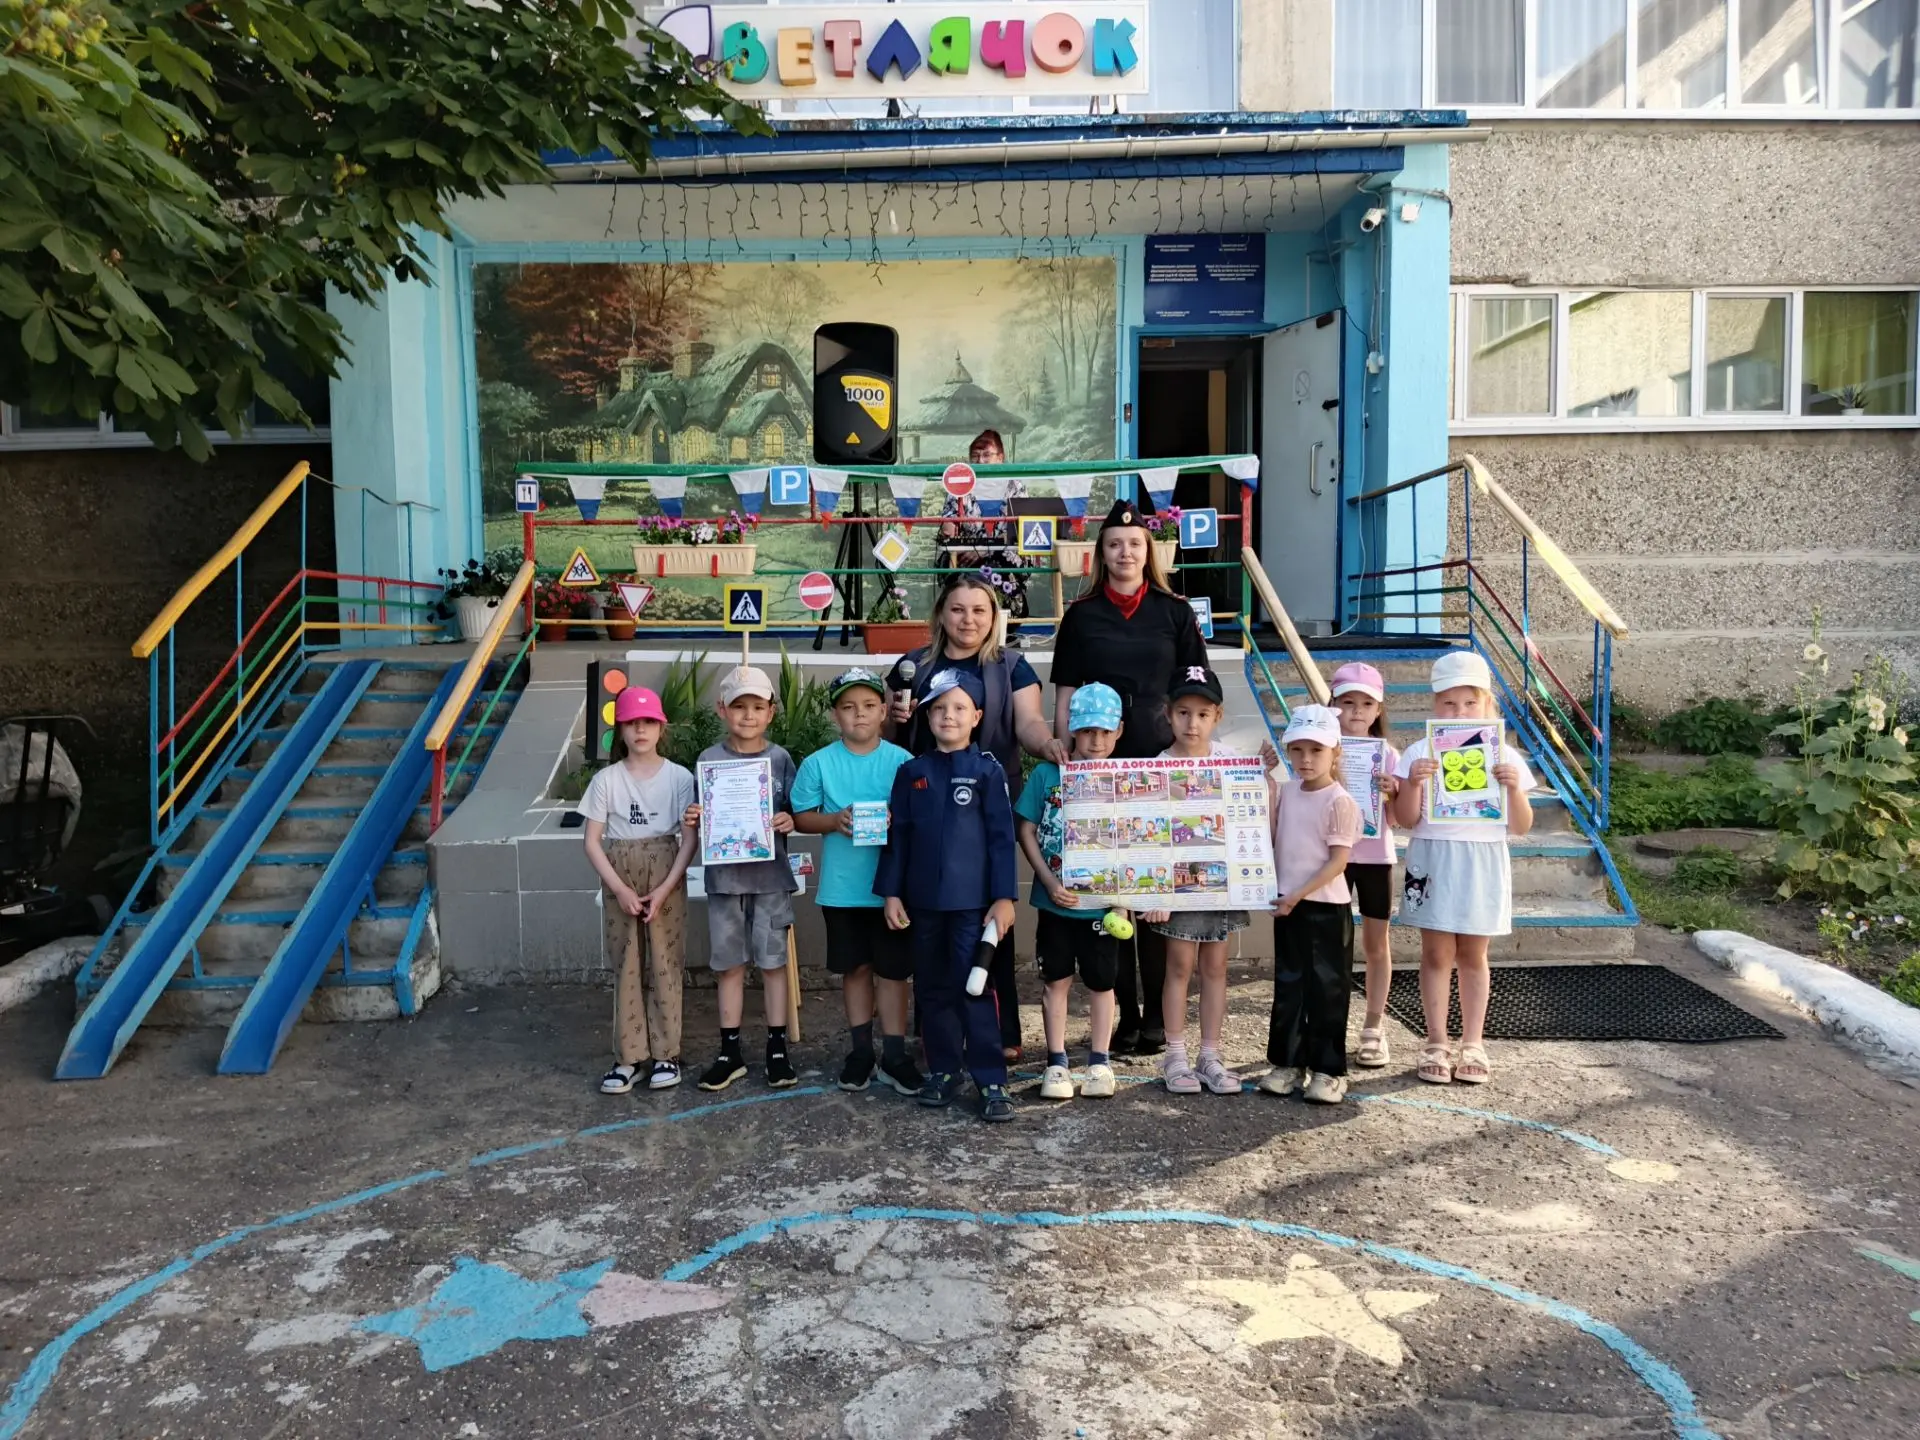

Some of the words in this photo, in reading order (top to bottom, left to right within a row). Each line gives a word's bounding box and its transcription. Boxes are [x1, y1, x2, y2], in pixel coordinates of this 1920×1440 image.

[846, 387, 885, 402] 1000
[781, 470, 801, 500] P
[1189, 513, 1211, 544] P
[1065, 761, 1119, 772] ПРАВИЛА
[1121, 760, 1195, 769] ДОРОЖНОГО
[1198, 757, 1261, 768] ДВИЖЕНИЯ
